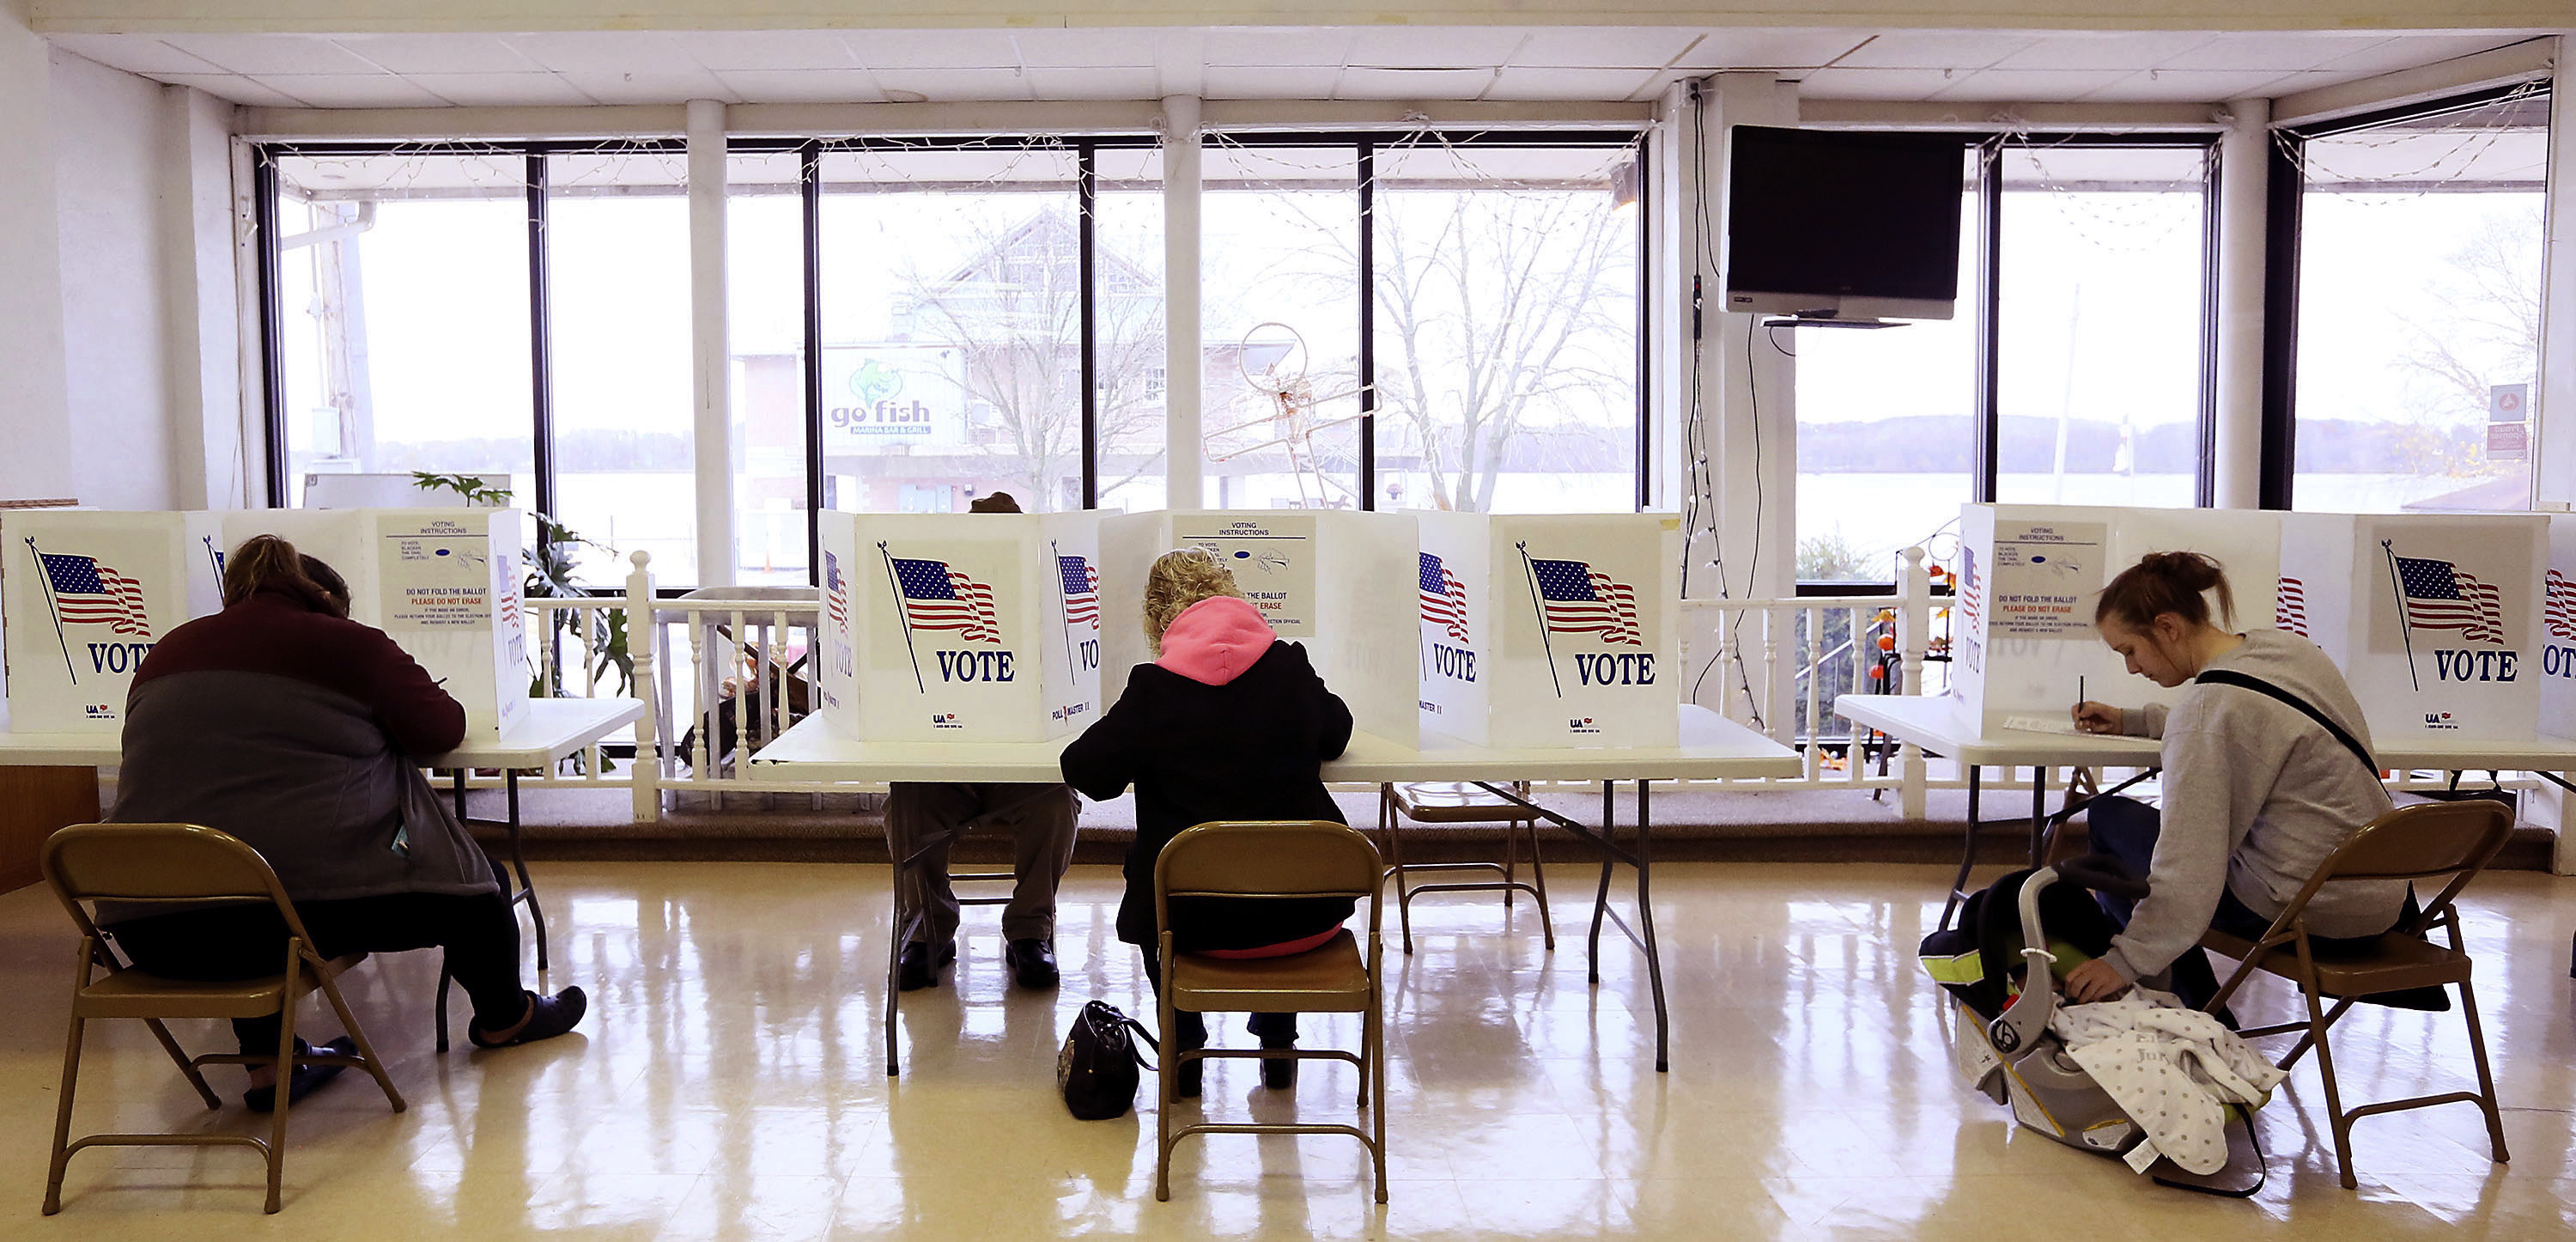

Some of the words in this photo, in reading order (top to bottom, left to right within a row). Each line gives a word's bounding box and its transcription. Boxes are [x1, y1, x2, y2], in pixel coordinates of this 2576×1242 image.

[831, 407, 866, 428] go
[875, 400, 930, 422] fish
[88, 642, 157, 673] VOT
[936, 650, 1015, 682] VOTE
[1079, 639, 1099, 671] VO
[1433, 642, 1477, 683] VOTE
[1575, 653, 1656, 685] VOTE
[2434, 649, 2518, 682] VOTE
[2543, 644, 2576, 679] OT
[86, 705, 99, 714] UA
[933, 715, 946, 723] UA
[1052, 709, 1064, 721] POLL
[1067, 703, 1084, 716] MASTER
[1570, 719, 1583, 728] UA
[2425, 714, 2440, 723] UA
